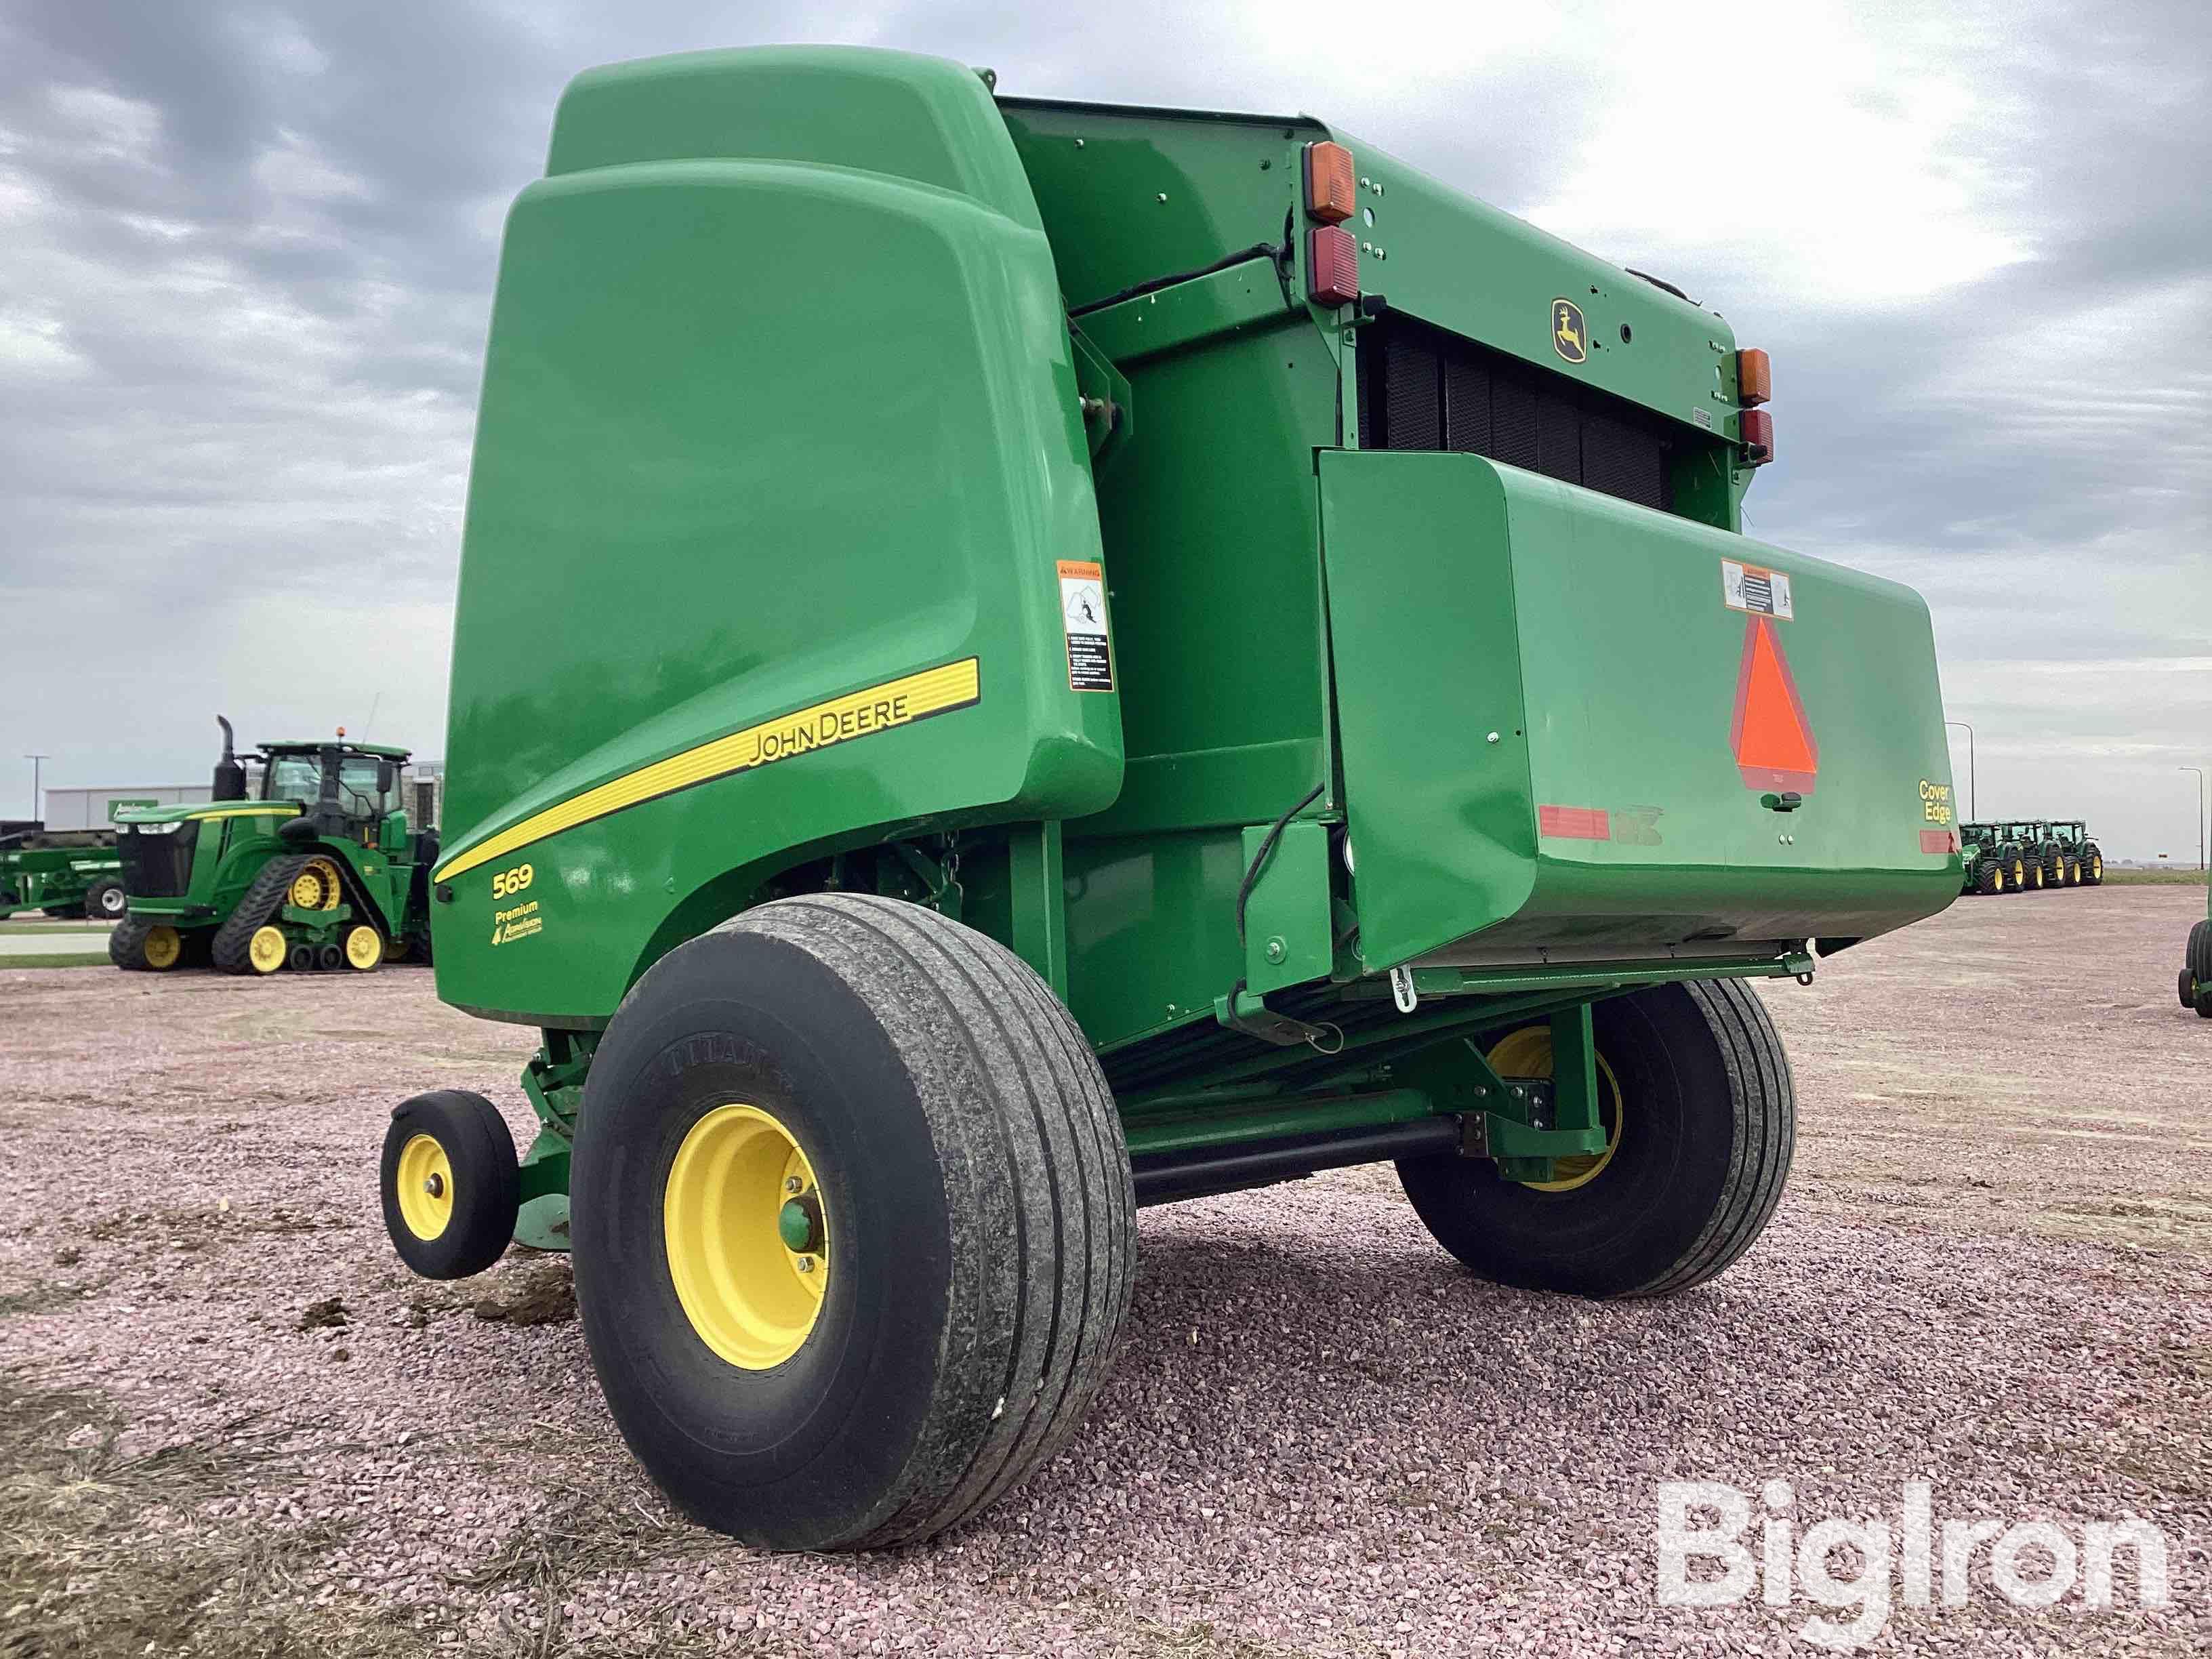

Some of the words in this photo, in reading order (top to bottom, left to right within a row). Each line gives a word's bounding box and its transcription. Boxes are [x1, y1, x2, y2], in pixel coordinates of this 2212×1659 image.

[1919, 780, 1950, 800] Cover
[1925, 801, 1951, 825] Edge
[493, 863, 533, 899] 569
[495, 901, 537, 925] Premium
